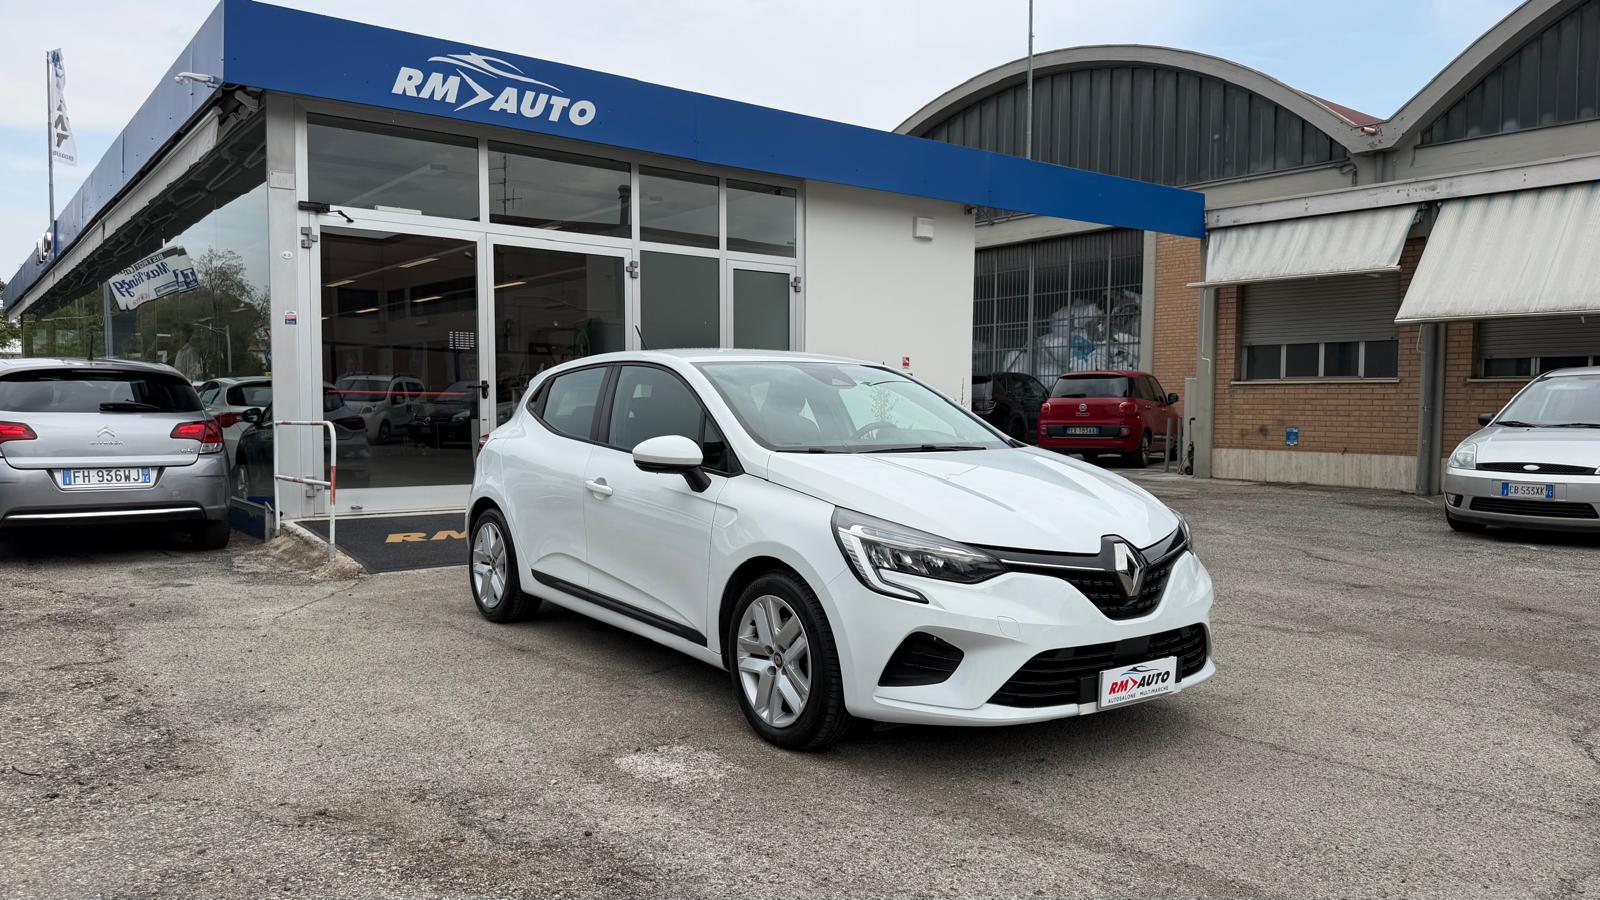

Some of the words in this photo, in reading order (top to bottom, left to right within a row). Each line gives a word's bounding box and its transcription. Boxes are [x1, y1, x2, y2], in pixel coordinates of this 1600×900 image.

[391, 66, 461, 104] RM
[489, 87, 596, 126] AUTO
[72, 469, 91, 483] FH
[96, 469, 140, 483] 936WJ
[1109, 680, 1129, 694] RM
[1137, 671, 1170, 688] AUTO
[1108, 694, 1136, 703] AUTOSALONE
